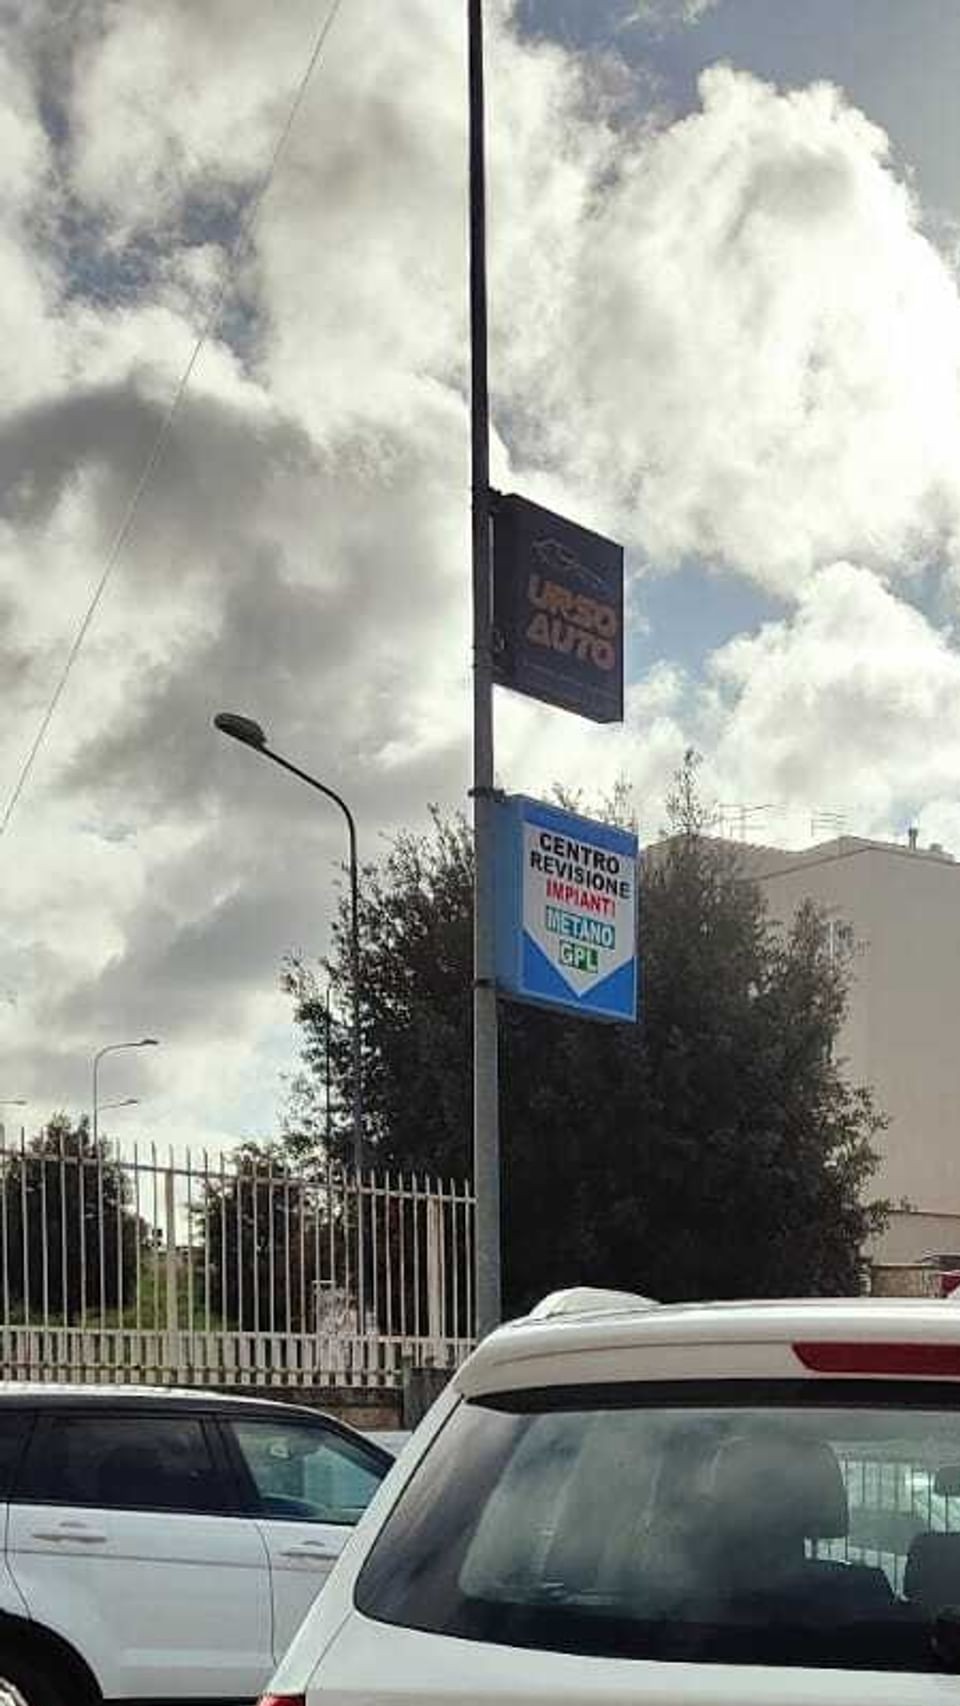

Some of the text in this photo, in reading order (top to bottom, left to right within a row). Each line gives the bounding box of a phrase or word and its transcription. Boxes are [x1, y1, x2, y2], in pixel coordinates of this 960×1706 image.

[528, 573, 618, 638] URSO
[526, 612, 617, 670] AUTO
[530, 850, 631, 899] REVISIONE
[539, 833, 621, 875] CENTRO
[546, 879, 616, 918] IMPIANTI
[548, 907, 614, 947] METANO
[560, 942, 599, 972] GPL
